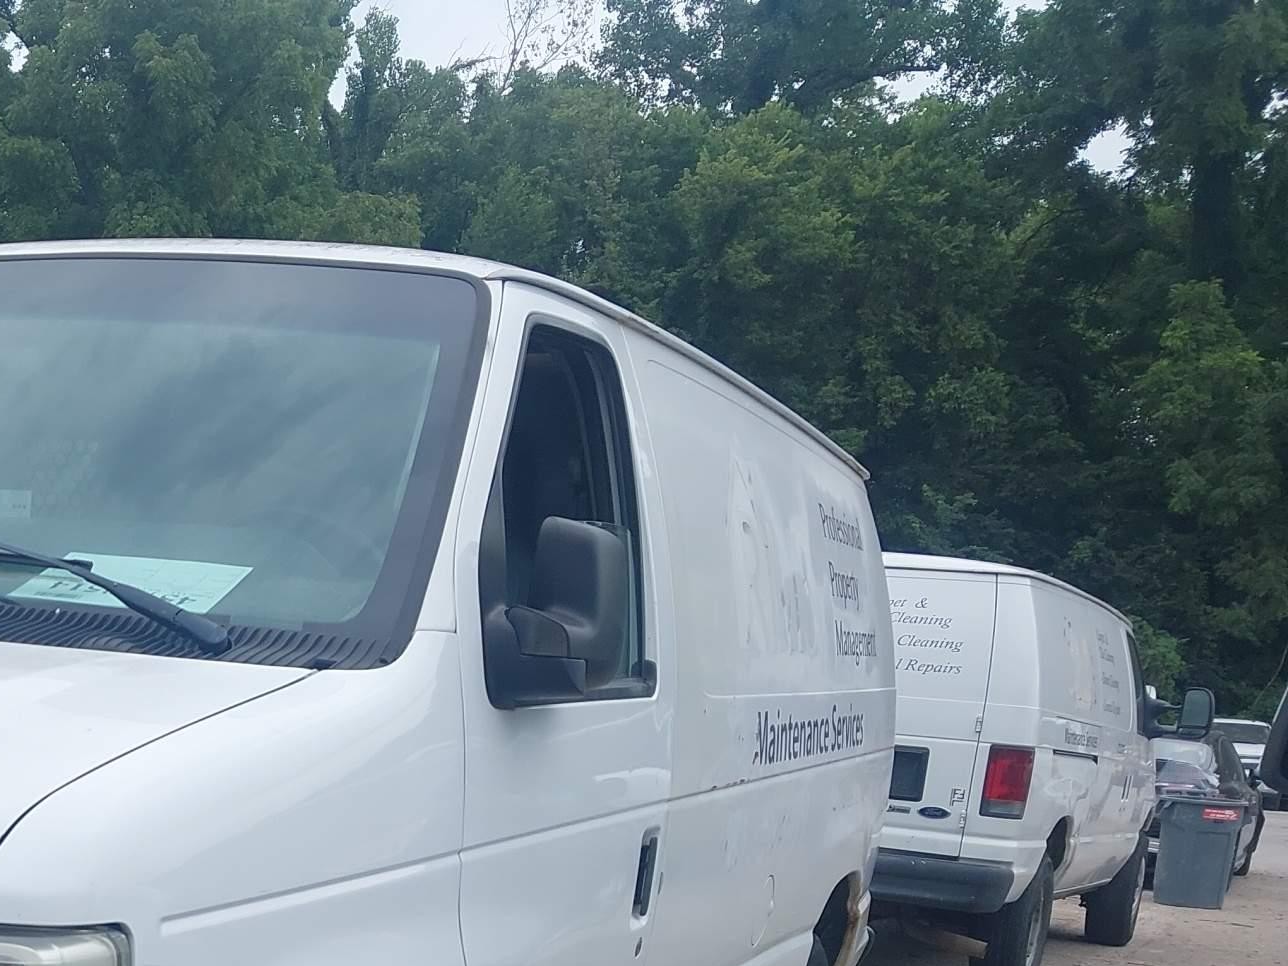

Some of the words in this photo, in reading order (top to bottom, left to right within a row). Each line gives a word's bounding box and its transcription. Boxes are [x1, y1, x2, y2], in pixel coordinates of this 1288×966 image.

[818, 503, 863, 551] Professional
[828, 561, 860, 611] Property
[915, 597, 928, 609] &
[835, 620, 877, 666] Management
[897, 634, 963, 653] Cleaning
[904, 659, 962, 675] Repairs
[753, 708, 830, 765] Maintenance
[831, 704, 864, 752] Services
